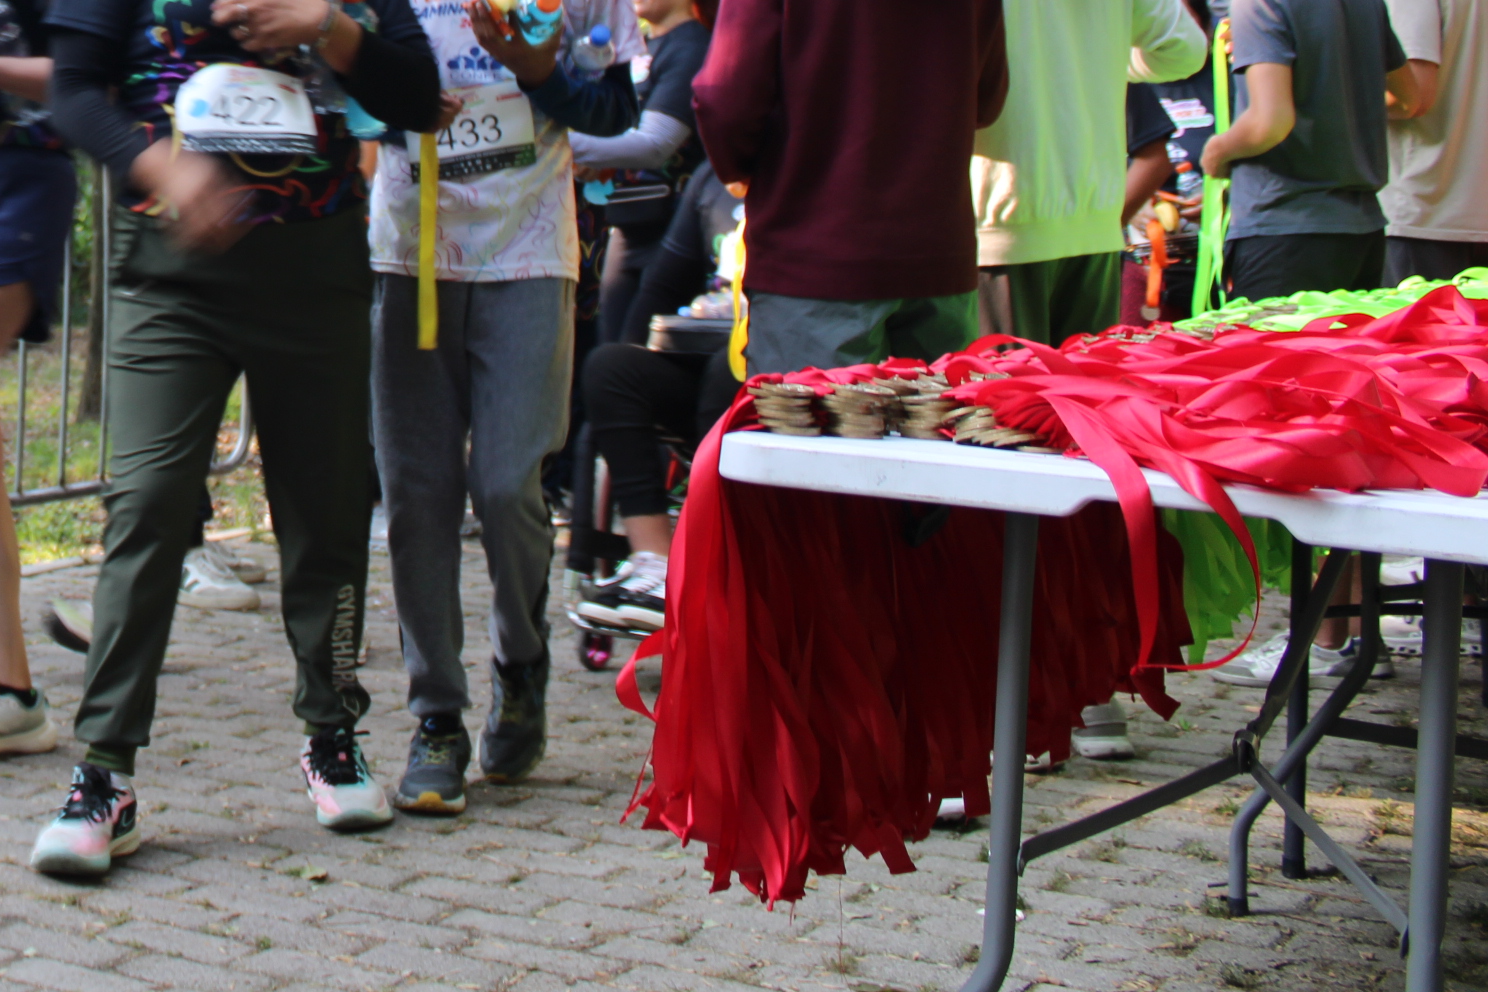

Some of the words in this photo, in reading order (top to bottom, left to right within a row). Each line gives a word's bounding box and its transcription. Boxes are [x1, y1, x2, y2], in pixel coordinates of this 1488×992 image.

[210, 95, 283, 127] 422
[437, 114, 502, 150] 433
[330, 584, 356, 693] GYMSHARK
